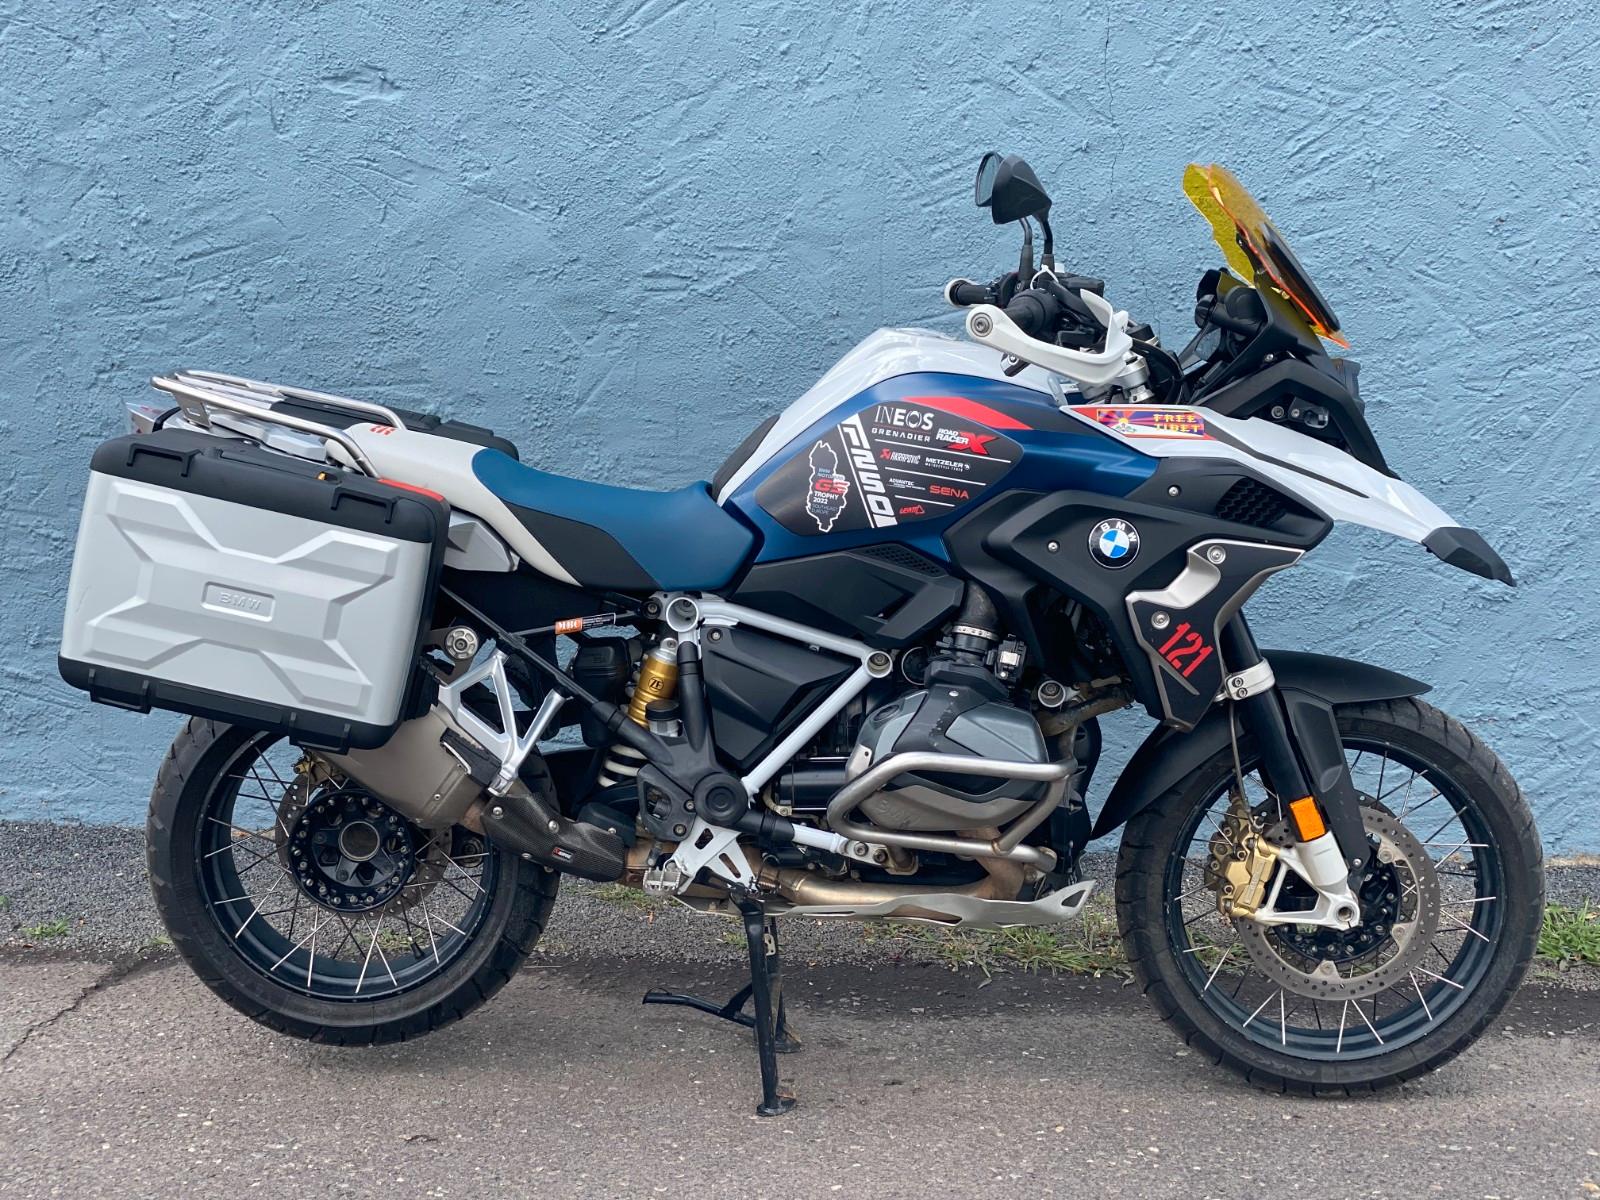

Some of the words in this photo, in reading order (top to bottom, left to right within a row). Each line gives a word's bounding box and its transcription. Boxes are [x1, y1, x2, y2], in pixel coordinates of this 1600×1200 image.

[874, 405, 935, 431] INEOS
[1153, 413, 1196, 423] FREE
[938, 427, 959, 436] ROAD
[1154, 423, 1200, 433] TIBET
[871, 427, 931, 442] GRENADIER
[936, 433, 970, 444] RACER
[925, 457, 964, 468] METZELER
[815, 478, 850, 494] GS
[814, 490, 840, 501] TROPHY
[929, 485, 970, 499] SENA
[813, 496, 828, 505] 2022
[1100, 520, 1138, 543] BMW
[220, 592, 262, 611] BMW
[1158, 622, 1213, 678] 121
[649, 679, 662, 689] ZF
